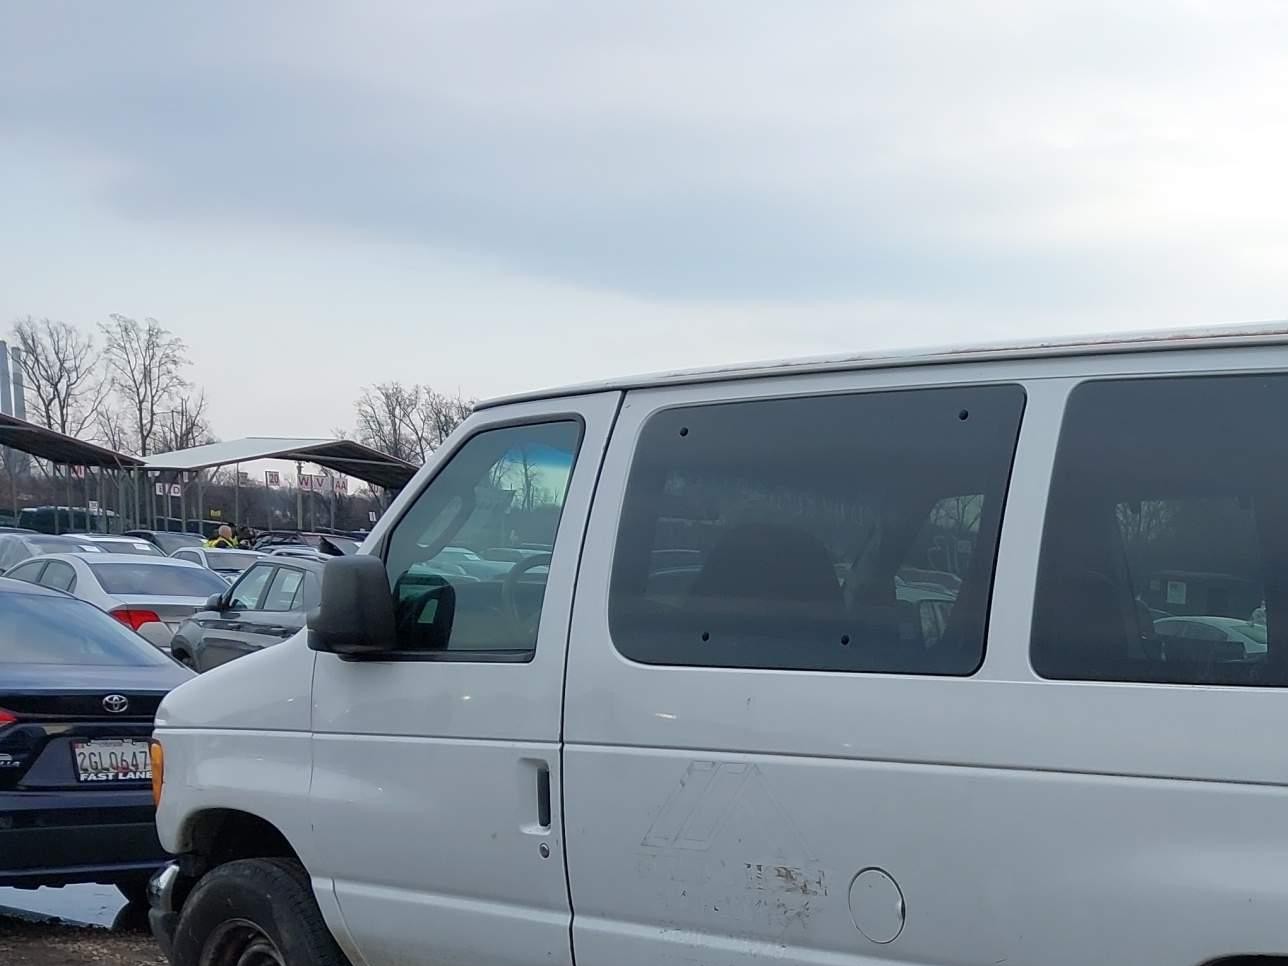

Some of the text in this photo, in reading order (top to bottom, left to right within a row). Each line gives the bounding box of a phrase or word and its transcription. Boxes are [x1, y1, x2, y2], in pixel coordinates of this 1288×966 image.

[299, 477, 309, 487] W
[335, 480, 347, 490] AA
[78, 750, 147, 772] 2GL0647
[80, 771, 153, 781] FAST LANE
